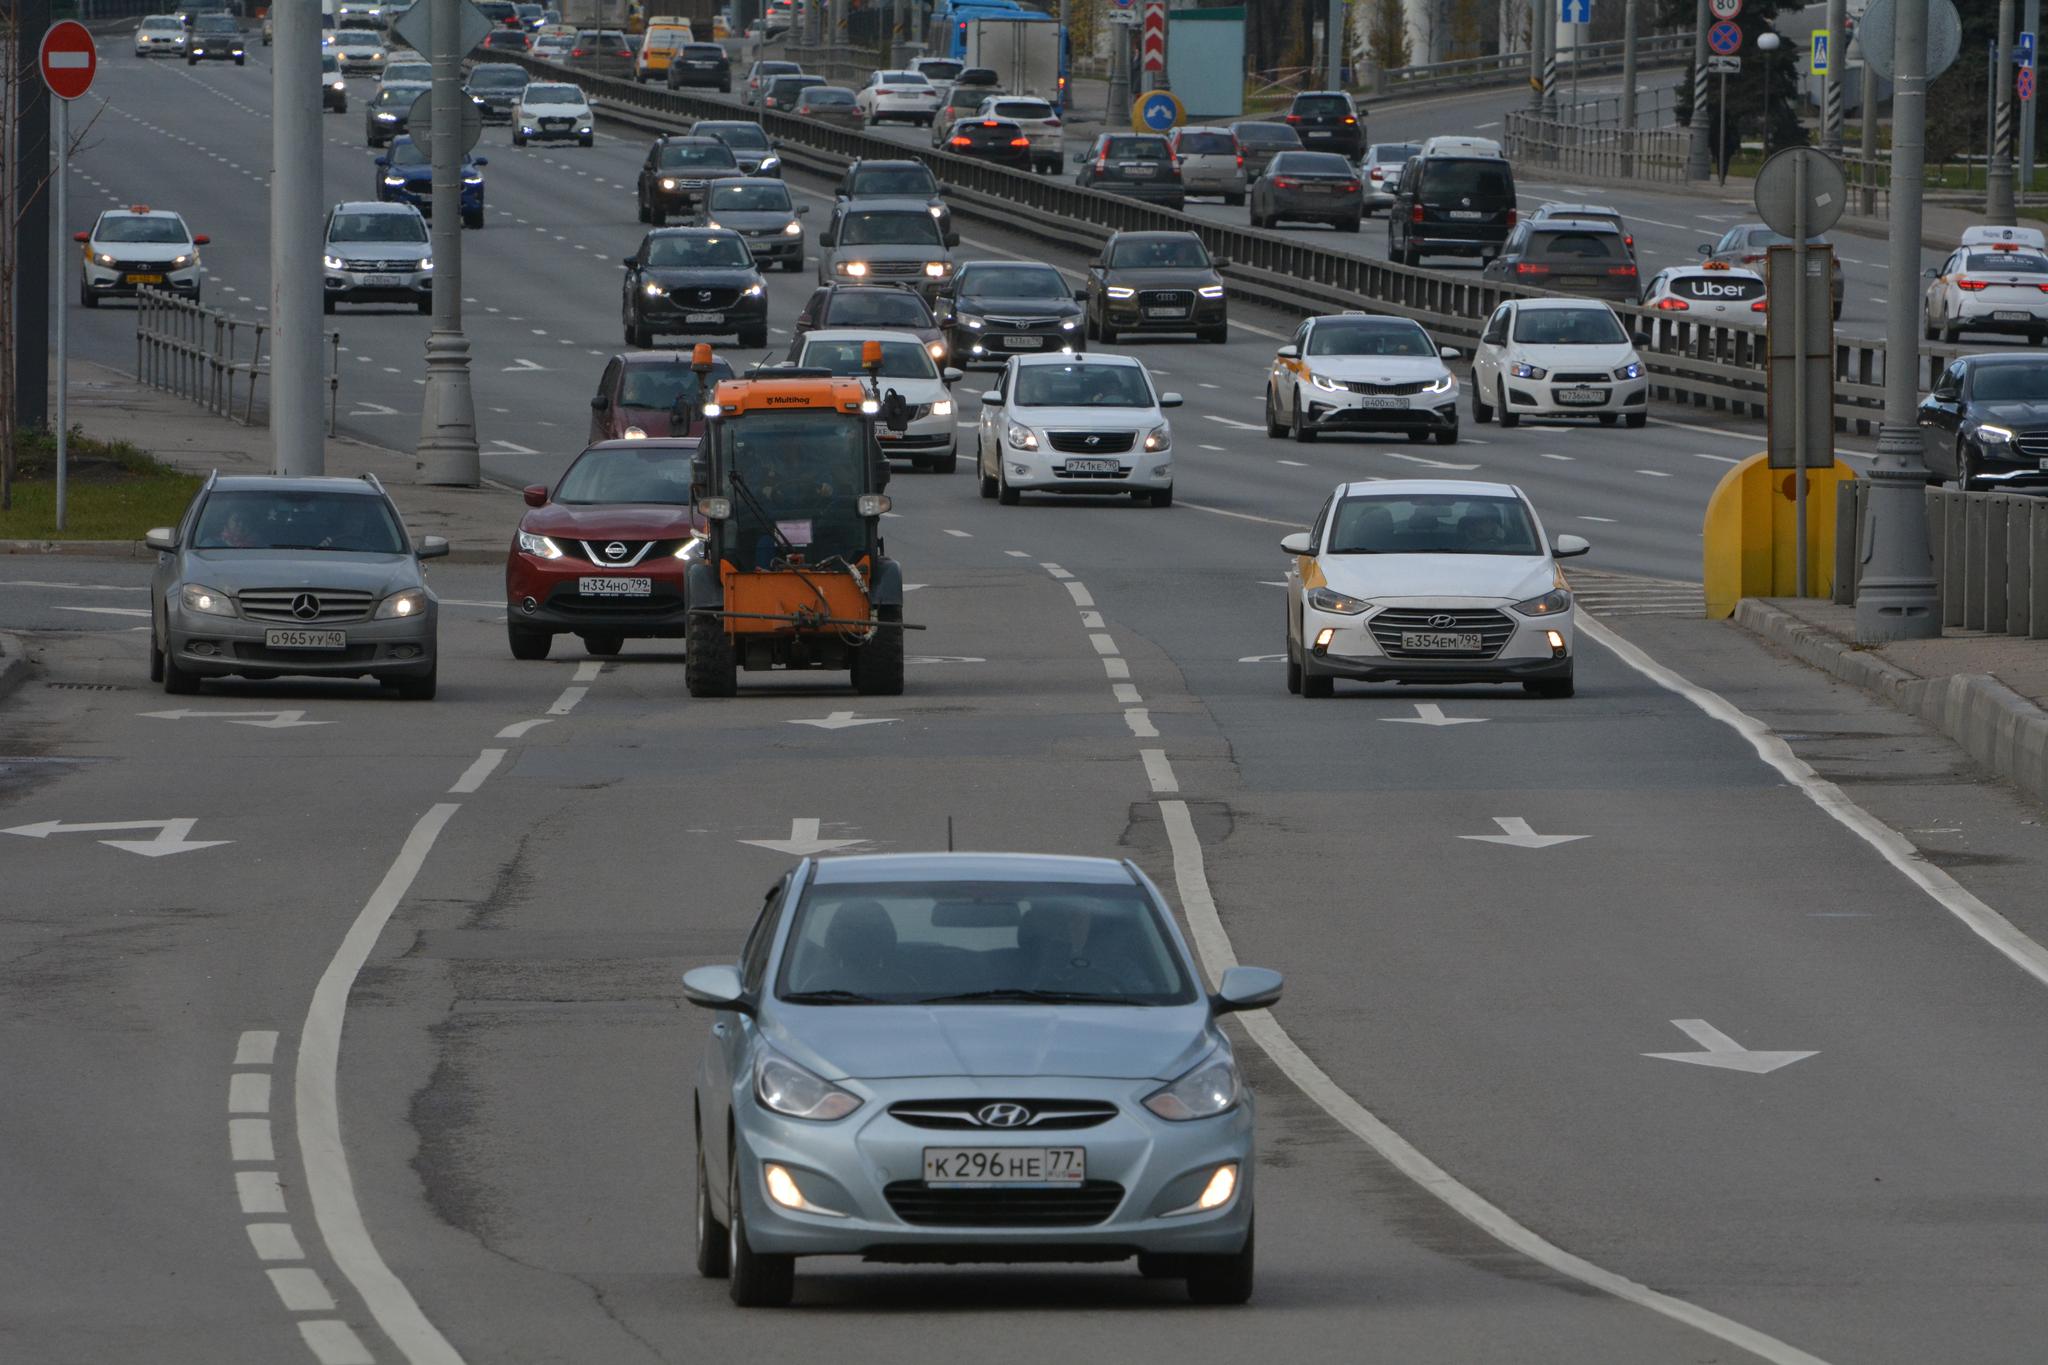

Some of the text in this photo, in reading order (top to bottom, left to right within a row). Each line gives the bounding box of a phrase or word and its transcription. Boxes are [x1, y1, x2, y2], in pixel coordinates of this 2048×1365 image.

[1691, 281, 1745, 296] Uber
[774, 396, 810, 405] Multihog
[1049, 1151, 1075, 1170] 77
